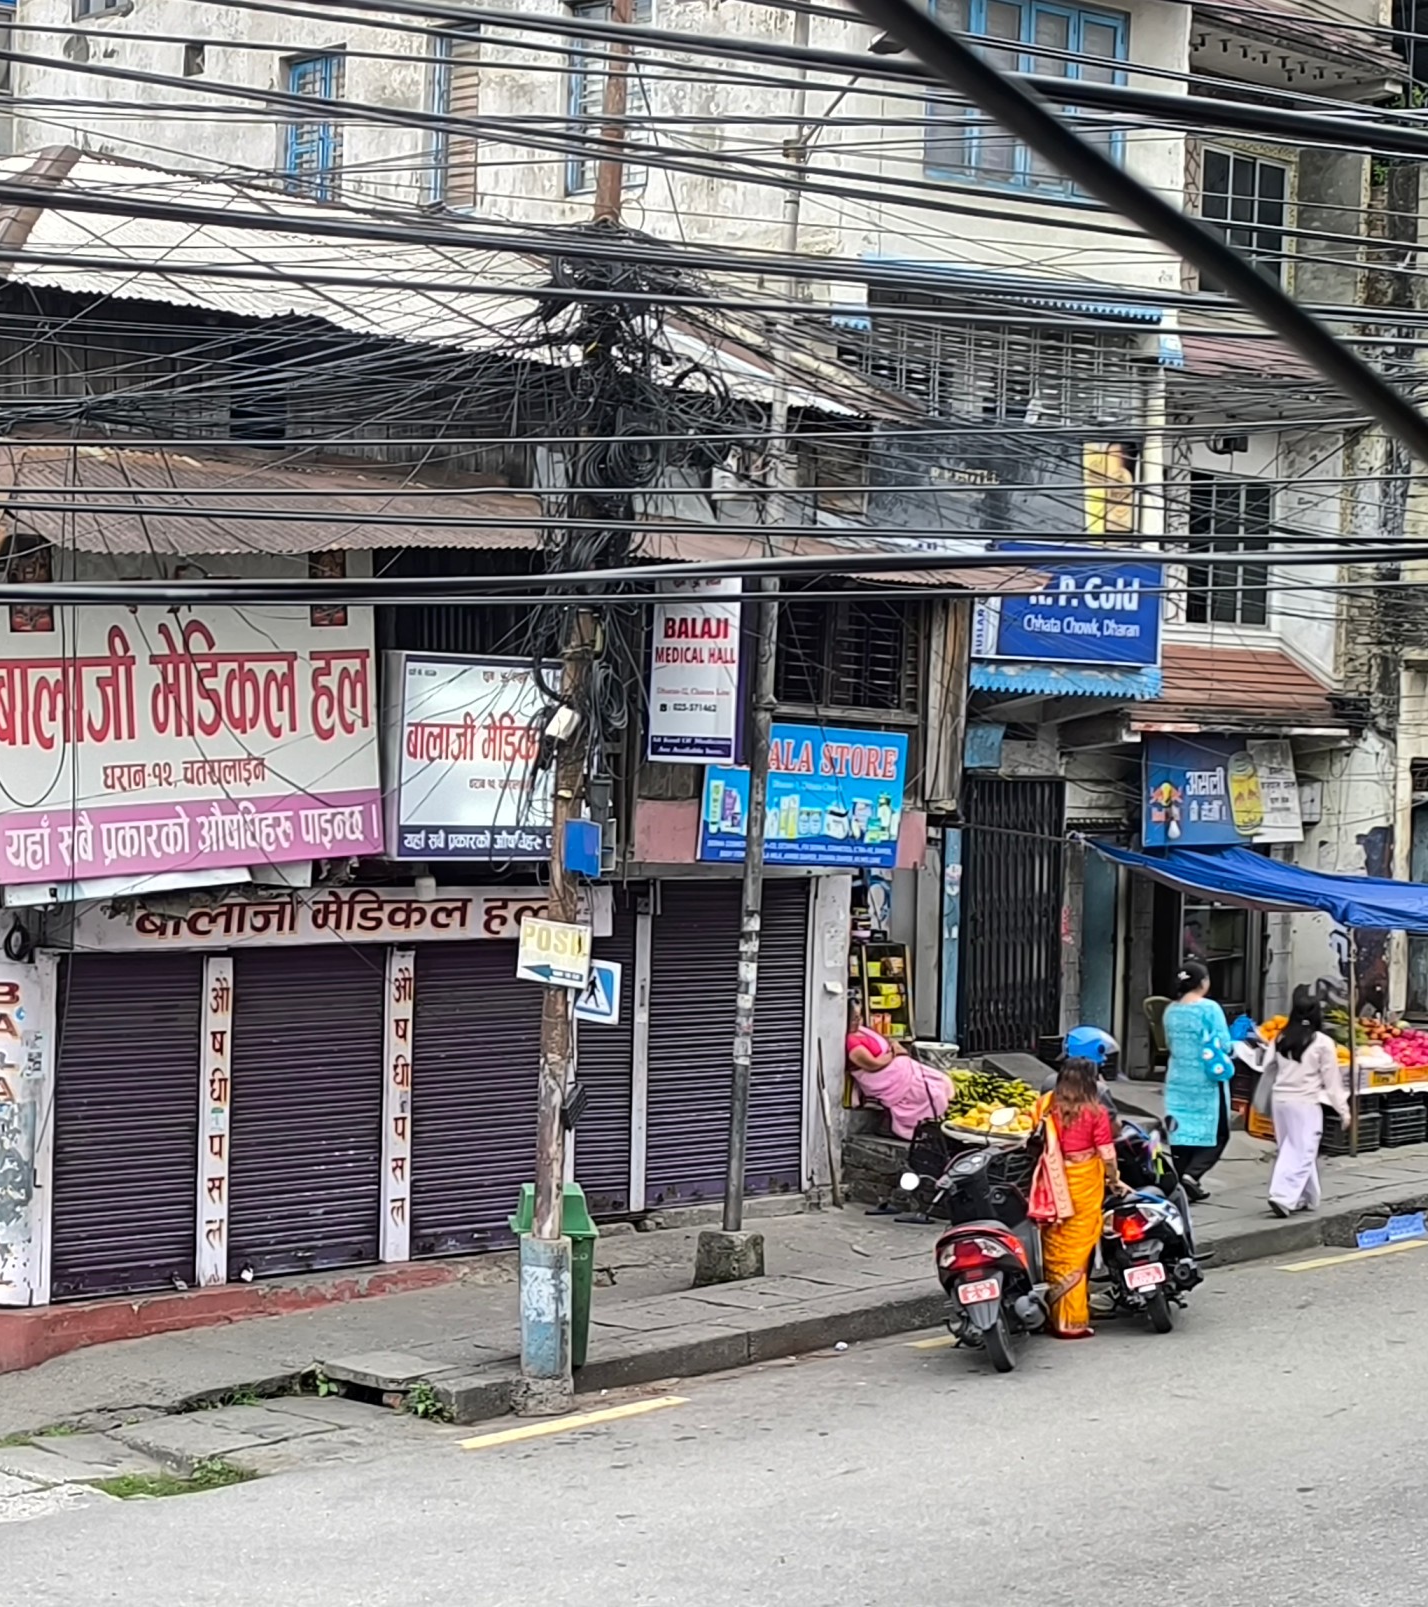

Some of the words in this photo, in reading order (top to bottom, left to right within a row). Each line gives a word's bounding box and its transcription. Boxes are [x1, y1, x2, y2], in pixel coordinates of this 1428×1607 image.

[1084, 576, 1140, 611] Cold
[663, 617, 729, 639] BALAJI
[1024, 614, 1061, 634] Chhata
[1103, 618, 1140, 638] Dharan
[655, 646, 704, 664] MEDICAL
[708, 647, 735, 664] HALL
[150, 619, 297, 738] मेडिकल
[310, 648, 370, 741] हल
[406, 711, 476, 762] बालाजी
[482, 711, 541, 762] मेडिक
[821, 742, 897, 780] STORE
[1185, 766, 1225, 796] असली
[5, 813, 50, 870] यहाँ
[57, 811, 93, 867] सबै
[100, 805, 190, 867] प्रकारको
[299, 806, 364, 850] पाइन्छ
[311, 890, 473, 932] मेडिकल
